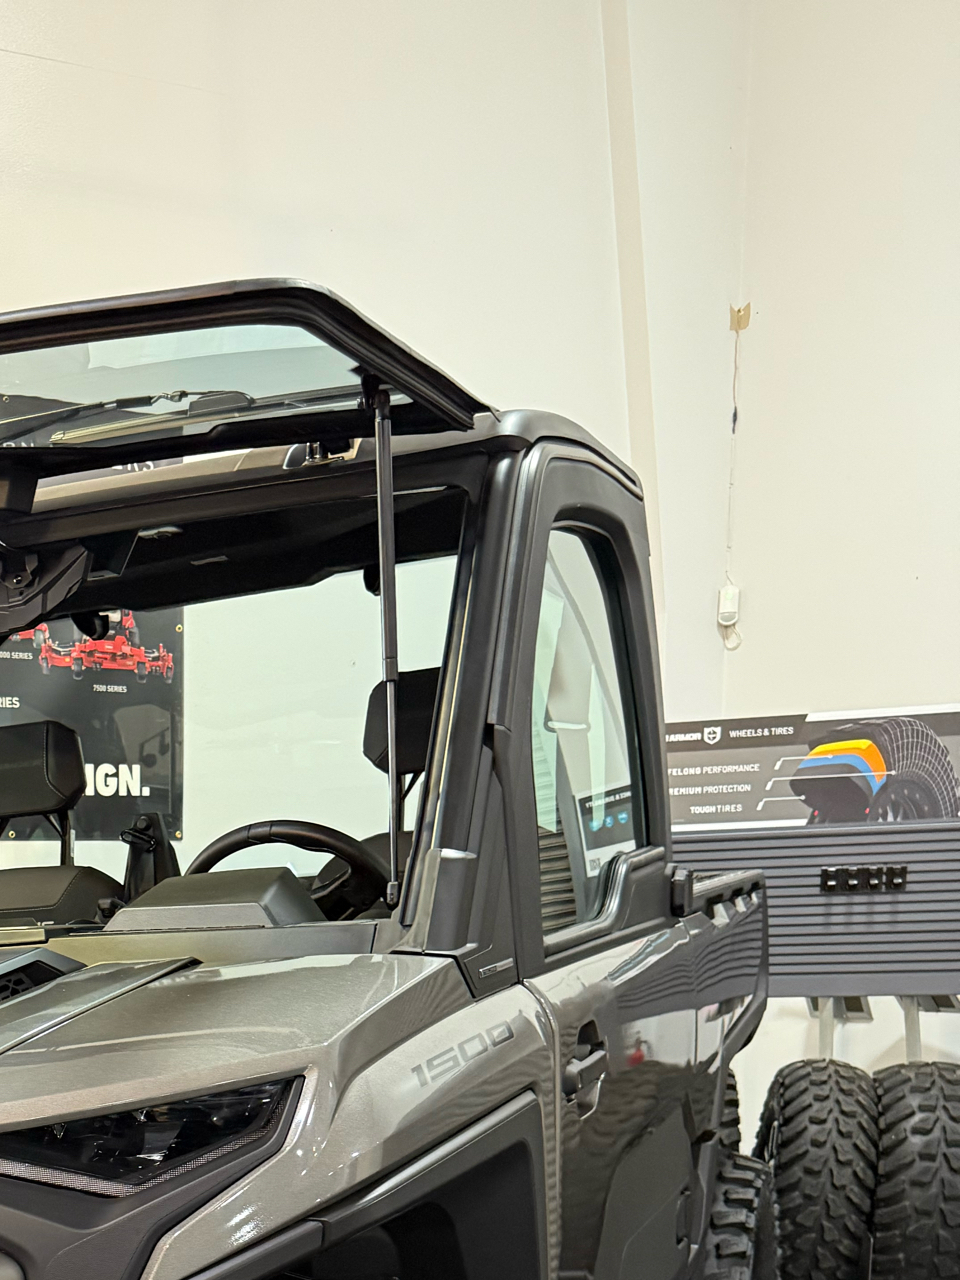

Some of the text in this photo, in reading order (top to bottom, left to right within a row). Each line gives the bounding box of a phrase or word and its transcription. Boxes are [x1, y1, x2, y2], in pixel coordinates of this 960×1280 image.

[11, 652, 33, 660] SERIES
[107, 685, 127, 693] SERIES
[729, 729, 762, 738] WHEELS
[763, 728, 770, 736] &
[771, 727, 794, 736] TIRES
[702, 764, 760, 775] PERFORMANCE
[703, 784, 751, 794] PROTECTION
[689, 804, 743, 814] TOUGH TIRES
[411, 1020, 515, 1088] 1500
